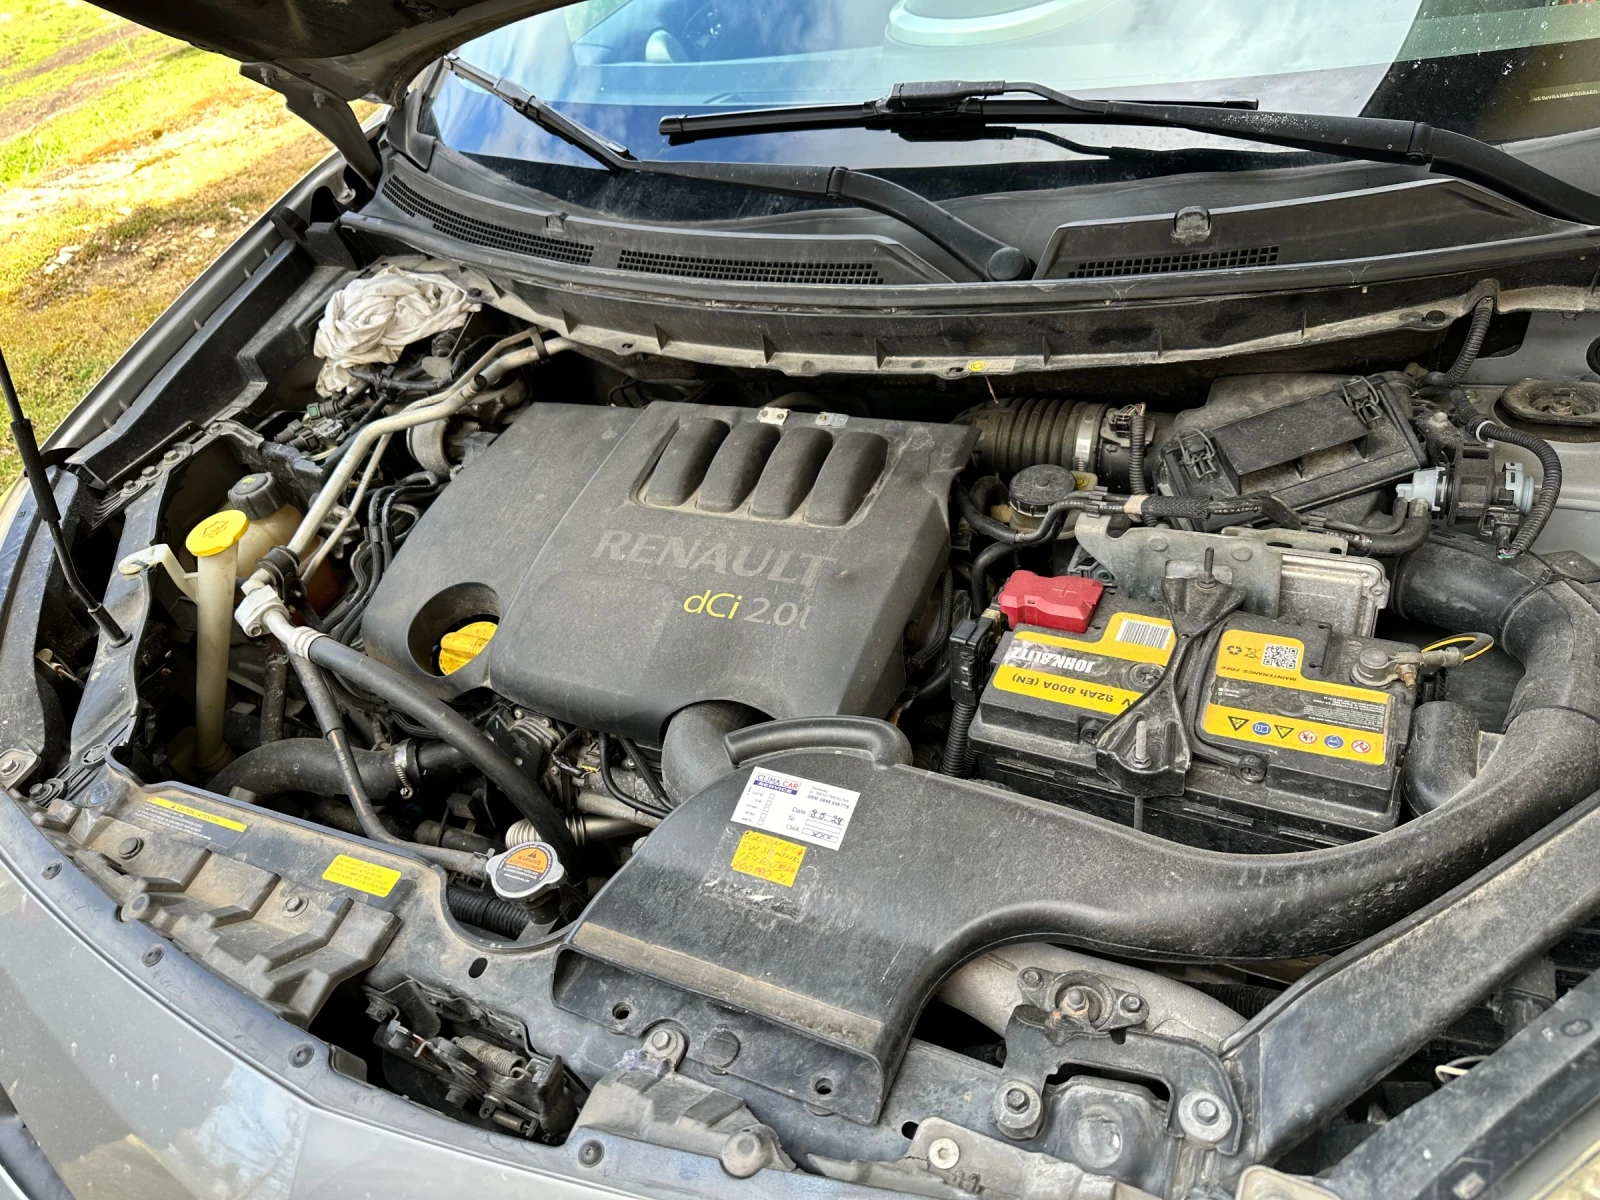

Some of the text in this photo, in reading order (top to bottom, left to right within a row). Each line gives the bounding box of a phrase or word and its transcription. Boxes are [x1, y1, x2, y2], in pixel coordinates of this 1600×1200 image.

[592, 529, 837, 588] RENAULT
[683, 589, 743, 620] dCi
[1012, 673, 1039, 686] (EN)
[1220, 665, 1297, 682] MAINTENANCE FREE
[1043, 681, 1076, 695] 800A
[1080, 688, 1114, 702] 92Ah
[757, 774, 780, 786] CLIMA
[782, 780, 799, 790] CAR
[758, 782, 794, 794] SERVICE
[792, 806, 806, 815] Date
[518, 856, 541, 865] WARNING
